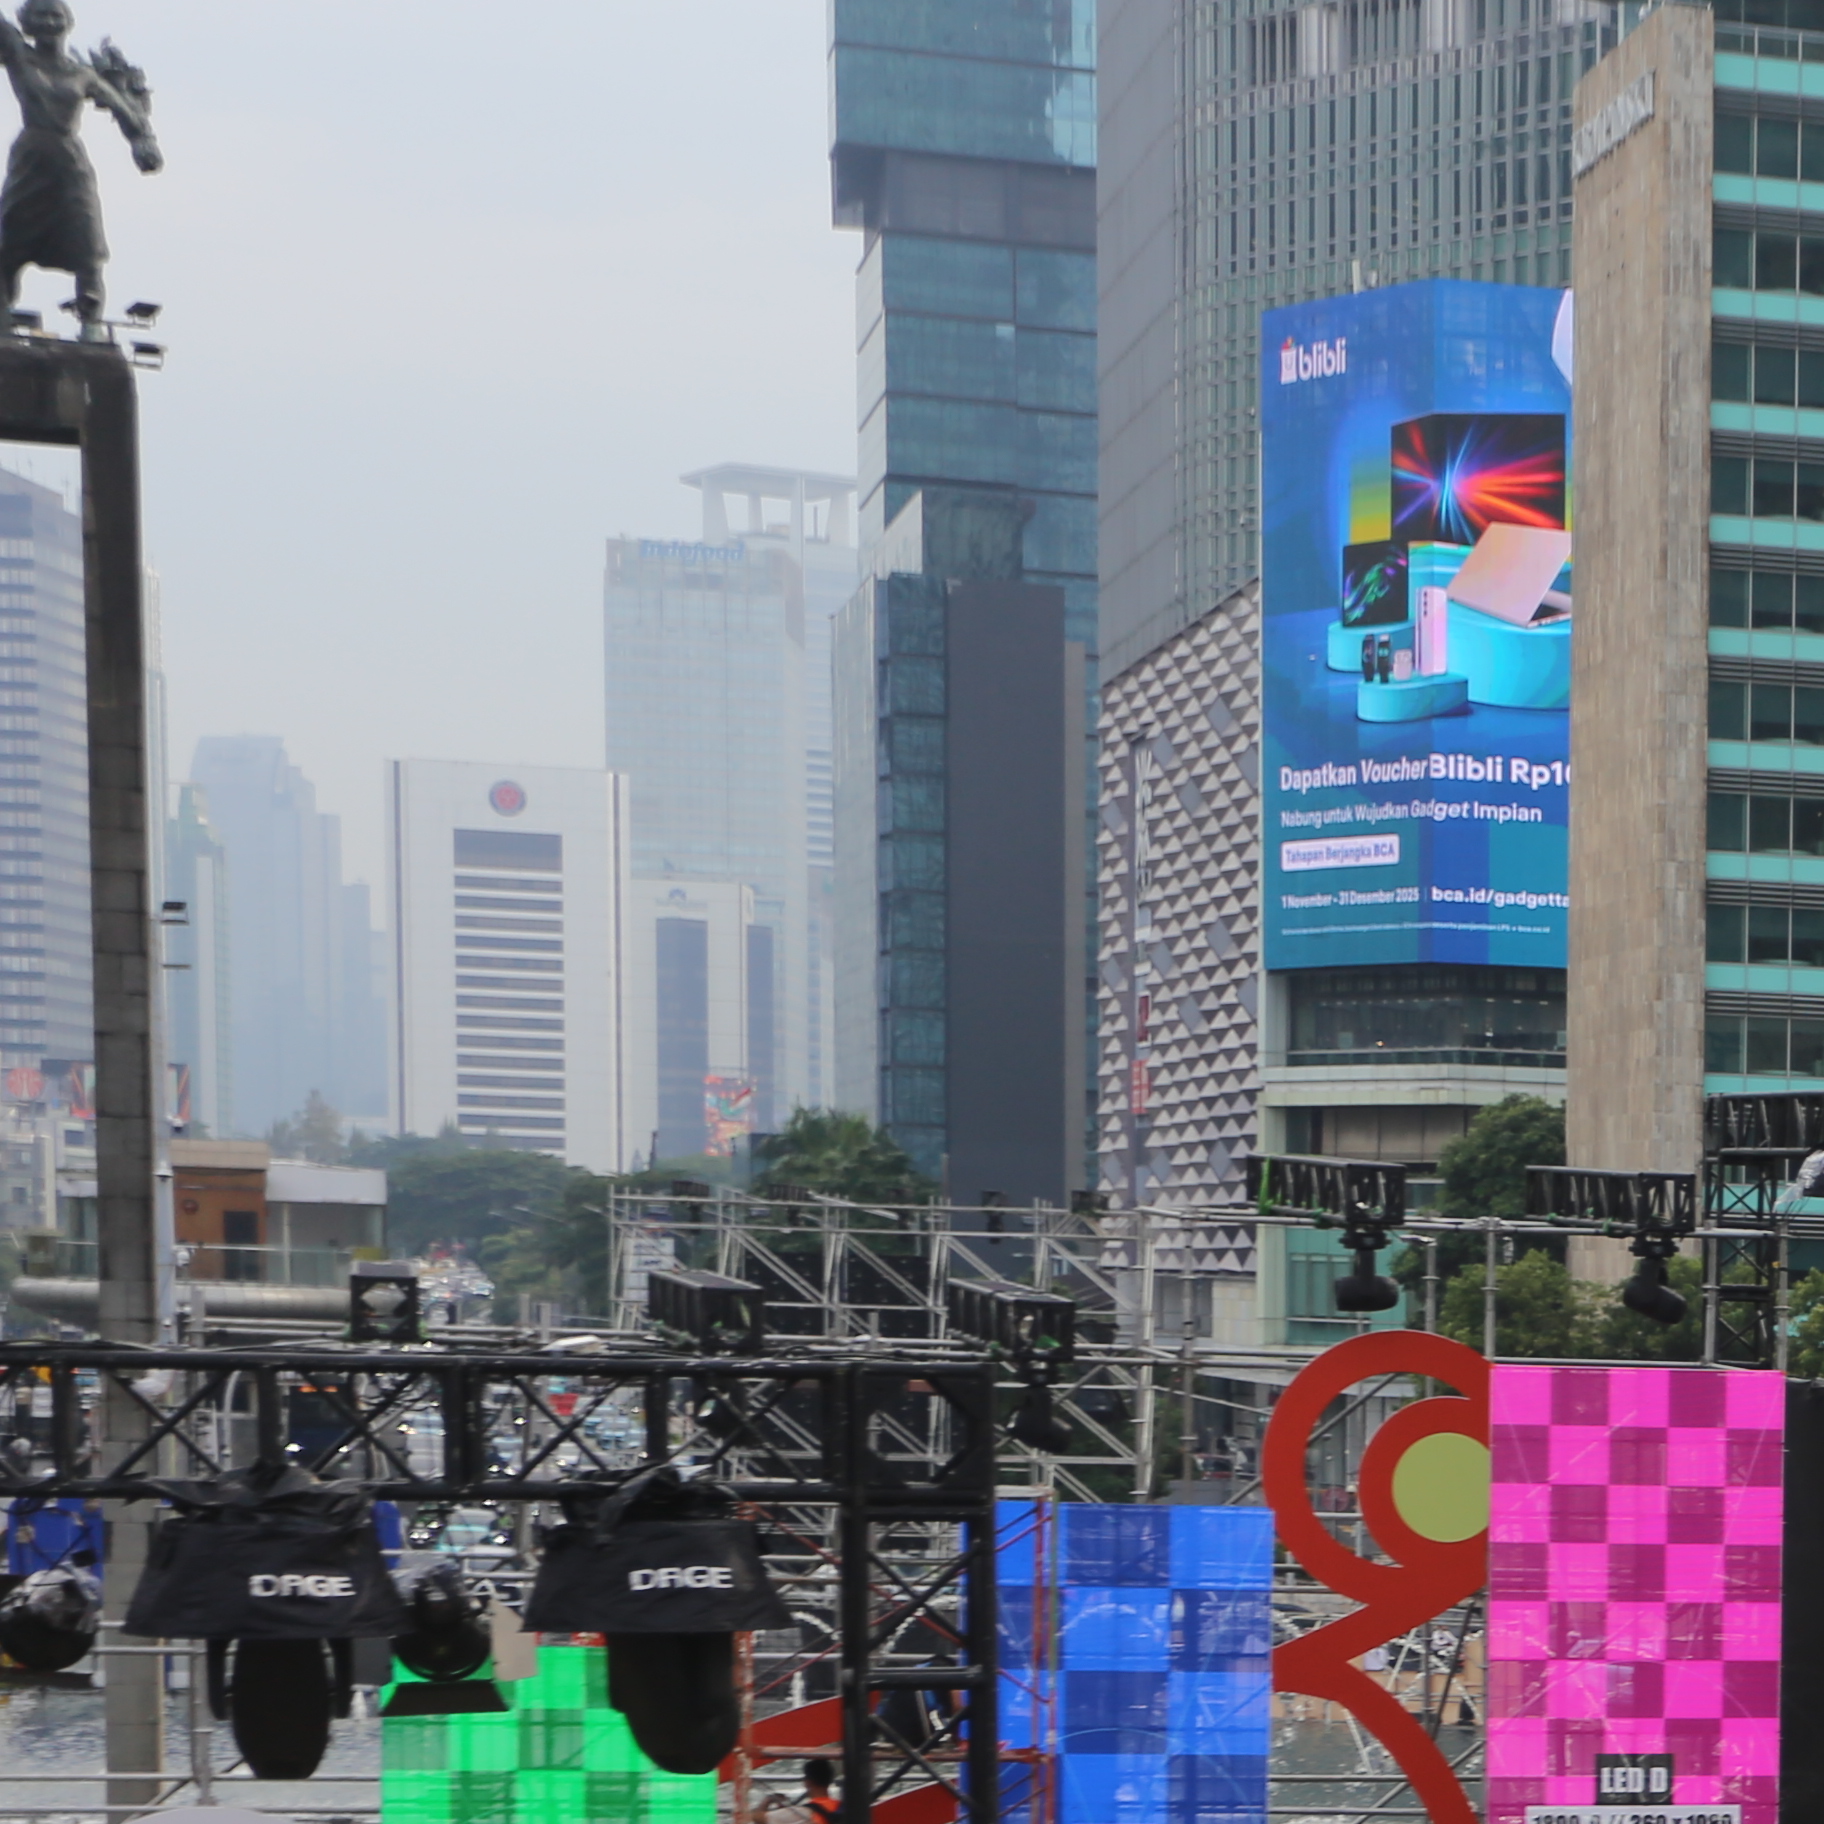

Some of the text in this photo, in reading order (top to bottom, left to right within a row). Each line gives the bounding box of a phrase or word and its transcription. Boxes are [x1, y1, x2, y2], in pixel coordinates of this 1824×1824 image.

[1298, 336, 1347, 381] blibli
[1280, 761, 1356, 795] Dapatkan
[1360, 755, 1429, 784] Voucher
[1429, 753, 1504, 783] Blibli
[1281, 798, 1543, 829] Nabung untuk Wujudkan Gadget Impian
[1285, 848, 1324, 864] Tahapan
[1373, 842, 1396, 857] BCA
[1287, 892, 1333, 908] November
[1396, 886, 1420, 903] 2025
[1600, 1767, 1668, 1793] LED D
